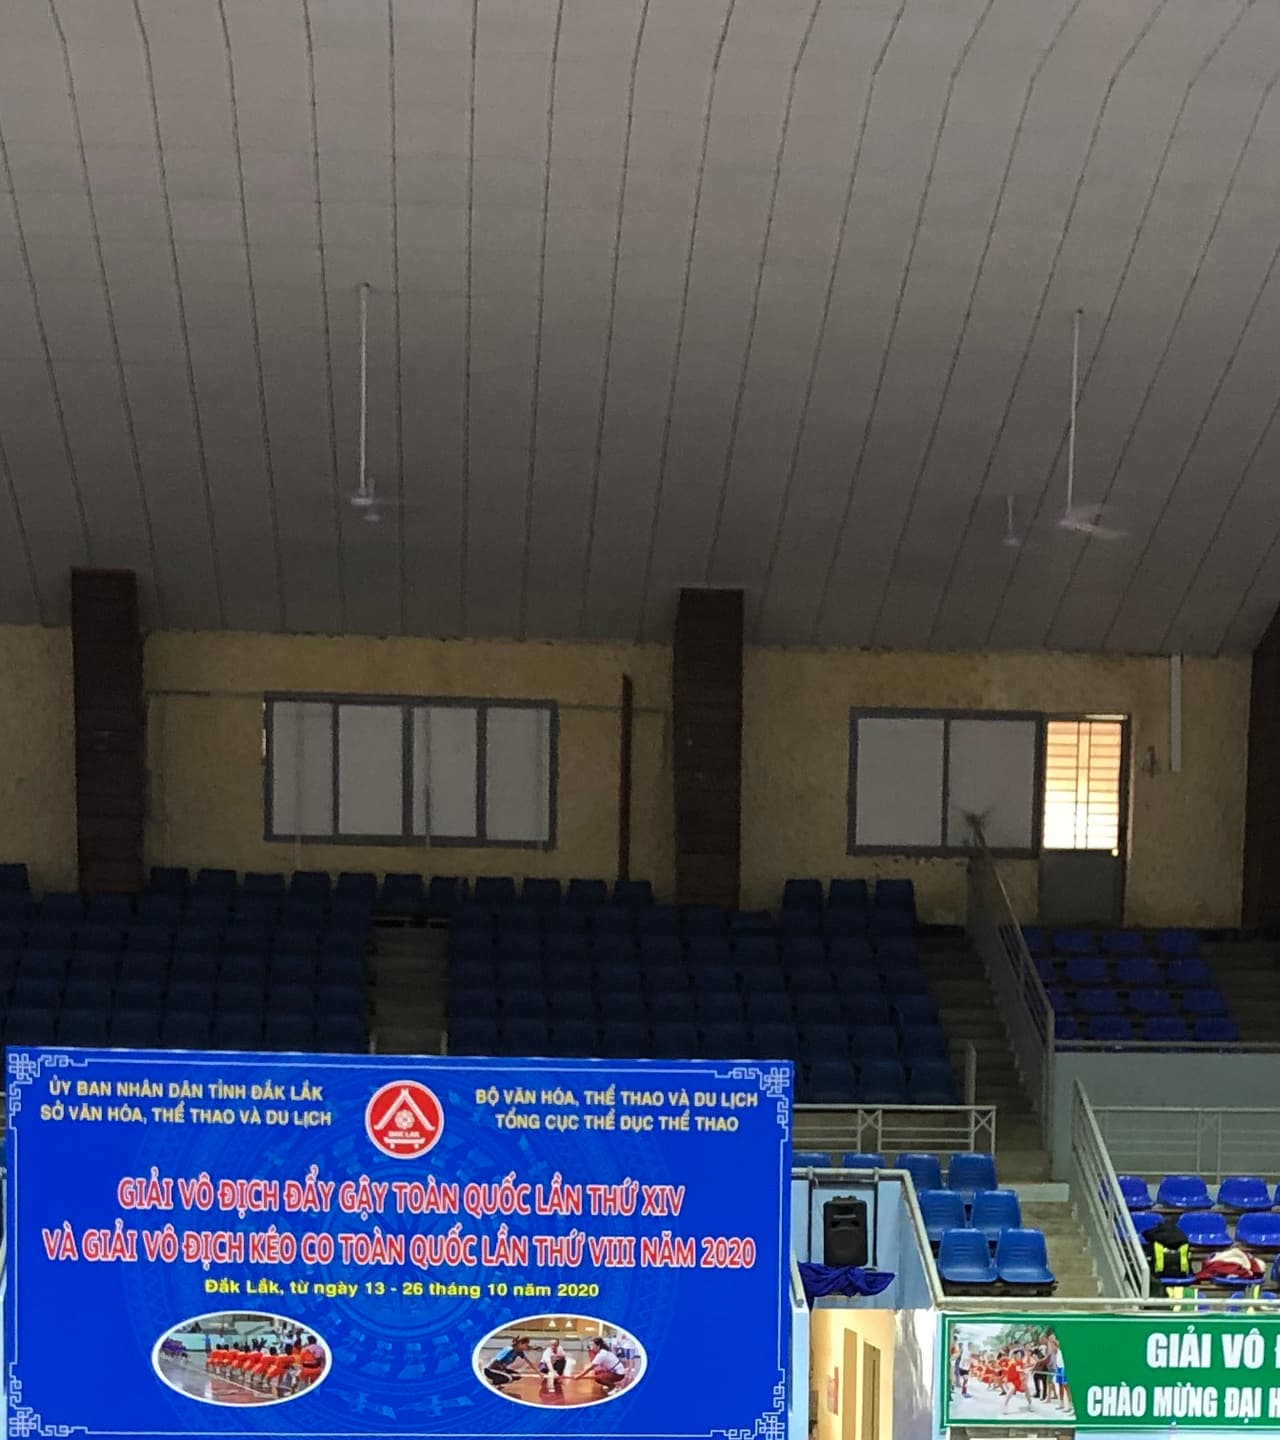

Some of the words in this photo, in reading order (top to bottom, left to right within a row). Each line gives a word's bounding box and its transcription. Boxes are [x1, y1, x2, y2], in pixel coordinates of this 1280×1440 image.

[77, 1082, 111, 1097] BAN
[117, 1078, 164, 1098] NHÂN
[168, 1078, 204, 1099] DÂN
[208, 1077, 246, 1099] TỈNH
[251, 1078, 285, 1100] ĐẮK
[290, 1080, 322, 1101] LẮK
[476, 1087, 498, 1106] BỘ
[503, 1087, 536, 1105] VĂN
[584, 1084, 615, 1105] THỂ
[620, 1091, 664, 1106] THAO
[668, 1088, 689, 1106] VÀ
[694, 1092, 717, 1107] DU
[721, 1092, 758, 1110] LỊCH
[40, 1100, 64, 1120] SỞ
[69, 1102, 102, 1121] VĂN
[152, 1099, 185, 1124] THỂ
[191, 1108, 234, 1125] THAO
[239, 1105, 261, 1125] VÀ
[266, 1109, 289, 1126] DU
[294, 1110, 331, 1129] LỊCH
[495, 1104, 539, 1130] TỔNG
[545, 1115, 579, 1132] CỤC
[584, 1108, 615, 1130] THỂ
[621, 1115, 653, 1133] DỤC
[659, 1109, 689, 1131] THỂ
[695, 1117, 738, 1132] THAO
[118, 1166, 173, 1209] GIẢI
[178, 1171, 214, 1210] VÔ
[218, 1181, 279, 1219] ĐỊCH
[284, 1164, 335, 1212] ĐẨY
[339, 1175, 388, 1220] GẬY
[393, 1175, 459, 1214] TOÀN
[464, 1171, 531, 1217] QUỐC
[536, 1172, 582, 1216] LẦN
[588, 1178, 638, 1216] THỨ
[641, 1185, 685, 1216] XIV
[42, 1220, 78, 1261] VÀ
[82, 1218, 137, 1262] GIẢI
[142, 1223, 178, 1262] VÔ
[183, 1231, 243, 1270] ĐỊCH
[250, 1225, 296, 1264] KÉO
[301, 1233, 333, 1264] CO
[338, 1227, 404, 1266] TOÀN
[410, 1222, 476, 1269] QUỐC
[482, 1223, 528, 1266] LẦN
[533, 1229, 585, 1267] THỨ
[588, 1237, 635, 1267] VIII
[640, 1231, 695, 1268] NĂM
[700, 1238, 756, 1269] 2020
[204, 1278, 240, 1294] Đắk
[246, 1278, 284, 1295] Lắk,
[290, 1280, 308, 1294] từ
[314, 1281, 358, 1298] ngày
[365, 1282, 385, 1294] 13
[402, 1282, 423, 1295] 26
[429, 1281, 481, 1298] tháng
[488, 1283, 508, 1296] 10
[513, 1282, 551, 1296] năm
[558, 1283, 599, 1297] 2020
[1147, 1325, 1211, 1368] GIẢI
[1222, 1328, 1265, 1369] VÔ
[1087, 1382, 1147, 1417] CHÀO
[1153, 1382, 1218, 1418] MỪNG
[1224, 1387, 1262, 1423] ĐẠI
